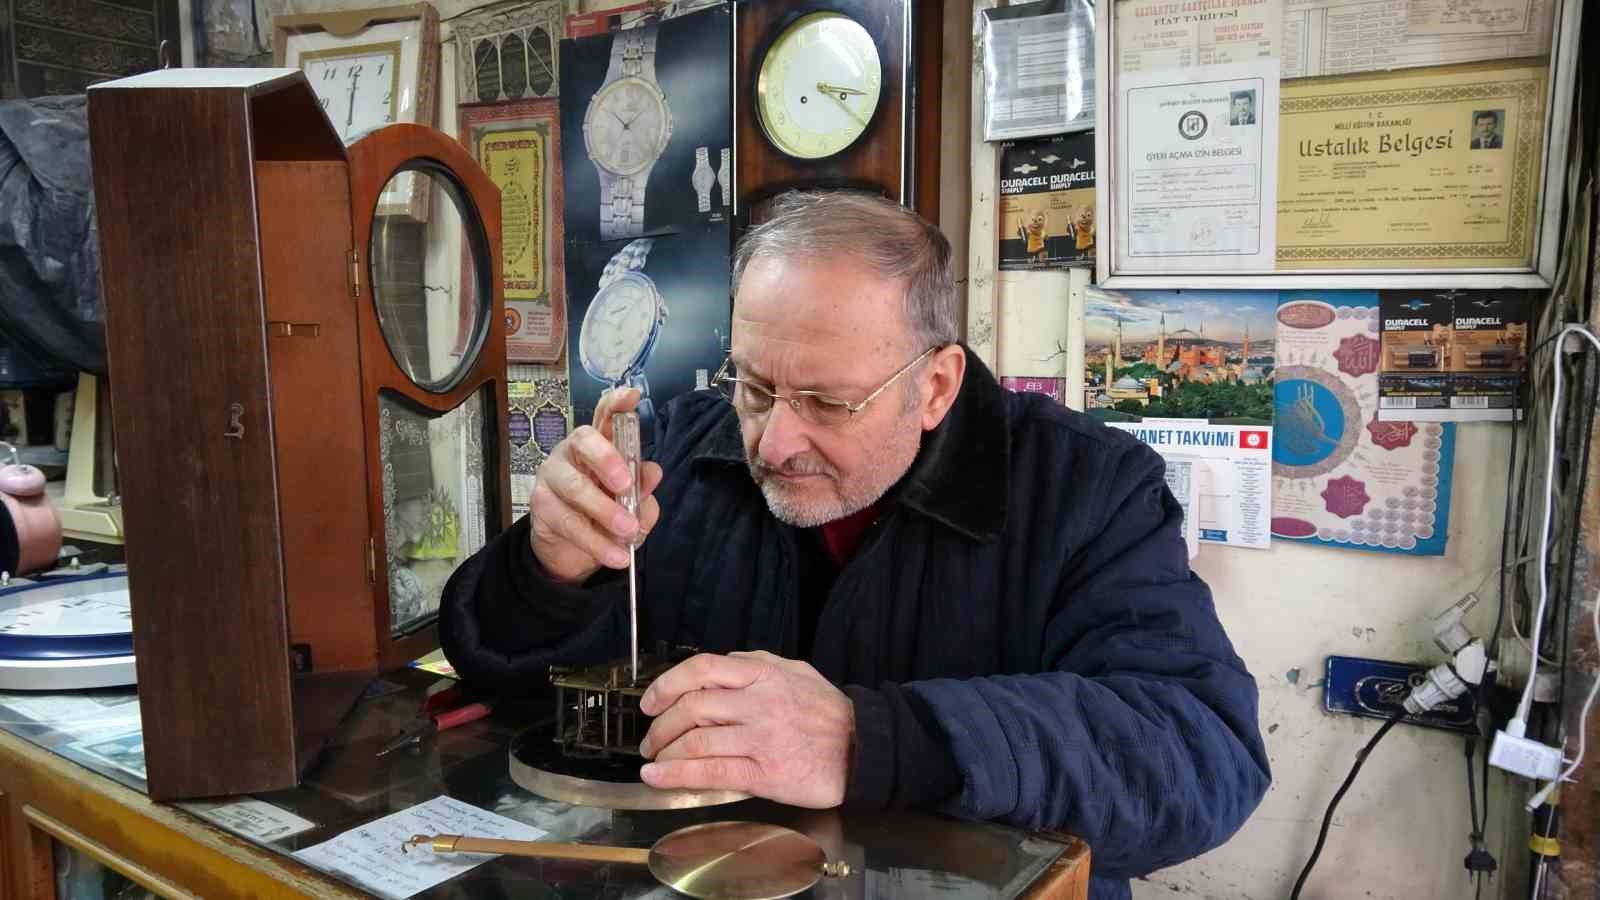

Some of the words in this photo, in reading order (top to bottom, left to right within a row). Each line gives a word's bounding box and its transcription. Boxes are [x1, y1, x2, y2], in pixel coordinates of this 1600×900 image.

[1299, 136, 1370, 157] Ustalık
[1378, 129, 1454, 157] Belgesi
[1050, 170, 1096, 184] DURACELL
[1001, 176, 1048, 188] DURACELL
[1050, 182, 1072, 190] SIMPLY
[1001, 186, 1024, 194] SIMPLY
[1384, 318, 1429, 326] DURACELL
[1455, 317, 1502, 326] DURACELL
